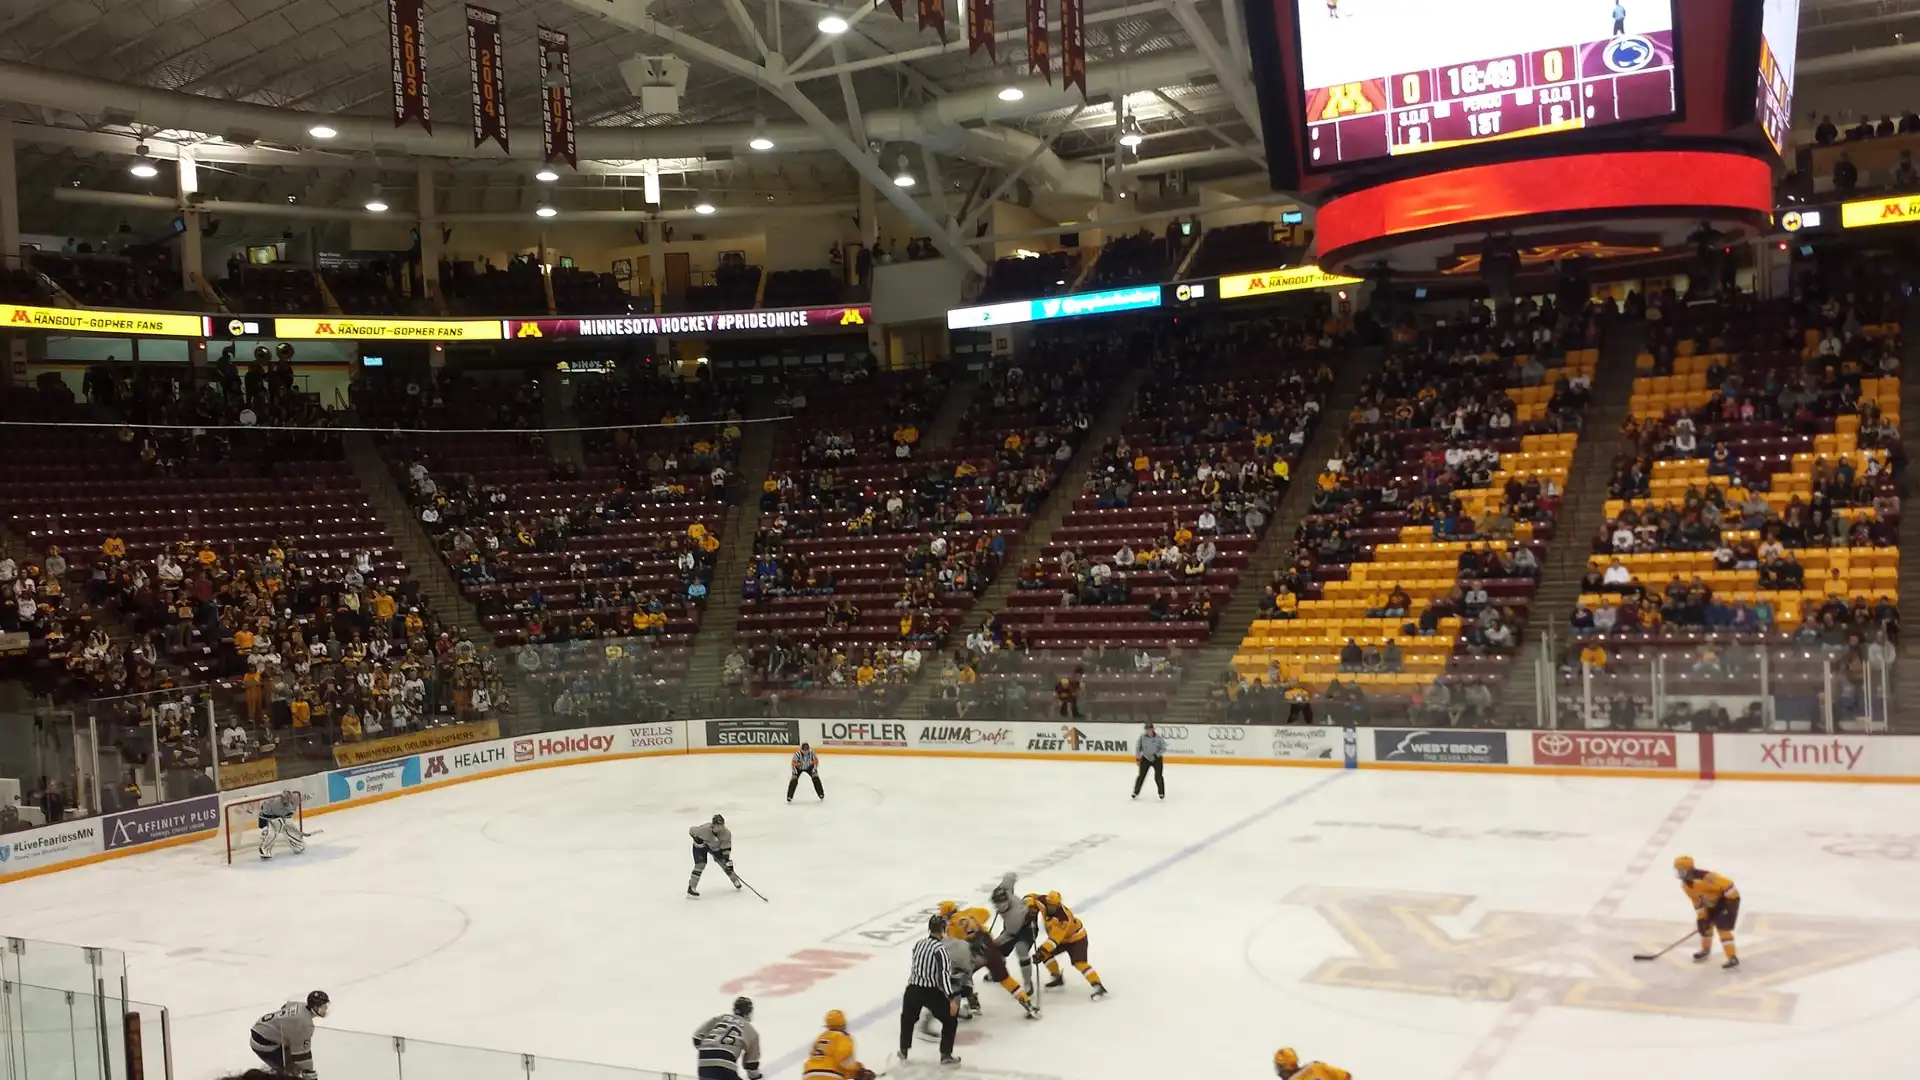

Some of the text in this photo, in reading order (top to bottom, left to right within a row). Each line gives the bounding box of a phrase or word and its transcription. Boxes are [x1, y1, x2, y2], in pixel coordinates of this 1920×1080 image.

[389, 0, 404, 118] TOURNAMENT
[404, 25, 416, 96] 2003
[417, 8, 430, 120] CHAMPIONS
[1543, 50, 1563, 82] 0
[468, 25, 483, 138] TOURNAMENT
[481, 49, 495, 116] 2004
[494, 33, 507, 138] CHAMPIONS
[1402, 74, 1420, 104] 0
[540, 45, 552, 154] TOUNAMENT
[1467, 111, 1501, 136] 1ST
[137, 321, 163, 330] FANS
[438, 327, 463, 336] FANS
[579, 318, 658, 336] MINNESOTA
[661, 315, 714, 334] HOCKEY
[717, 311, 808, 331] #PRIDEONICE
[630, 727, 673, 737] WELLS
[631, 736, 673, 747] FARGO
[719, 732, 789, 744] SECURIAN
[821, 723, 907, 740] LOFFLER
[355, 731, 474, 761] MINNESOTA GOLDEN GOPHERS
[454, 747, 505, 768] HEALTH
[538, 734, 614, 756] Holiday
[1027, 738, 1128, 752] FLEET FARM
[1411, 743, 1489, 754] WEST BEND
[1576, 737, 1671, 756] TOYOTA
[1761, 738, 1863, 770] xfinity
[366, 782, 384, 793] Energy
[137, 814, 186, 834] AFFINITY
[190, 808, 217, 822] PLUS
[13, 827, 94, 852] #LiveFearlessMN
